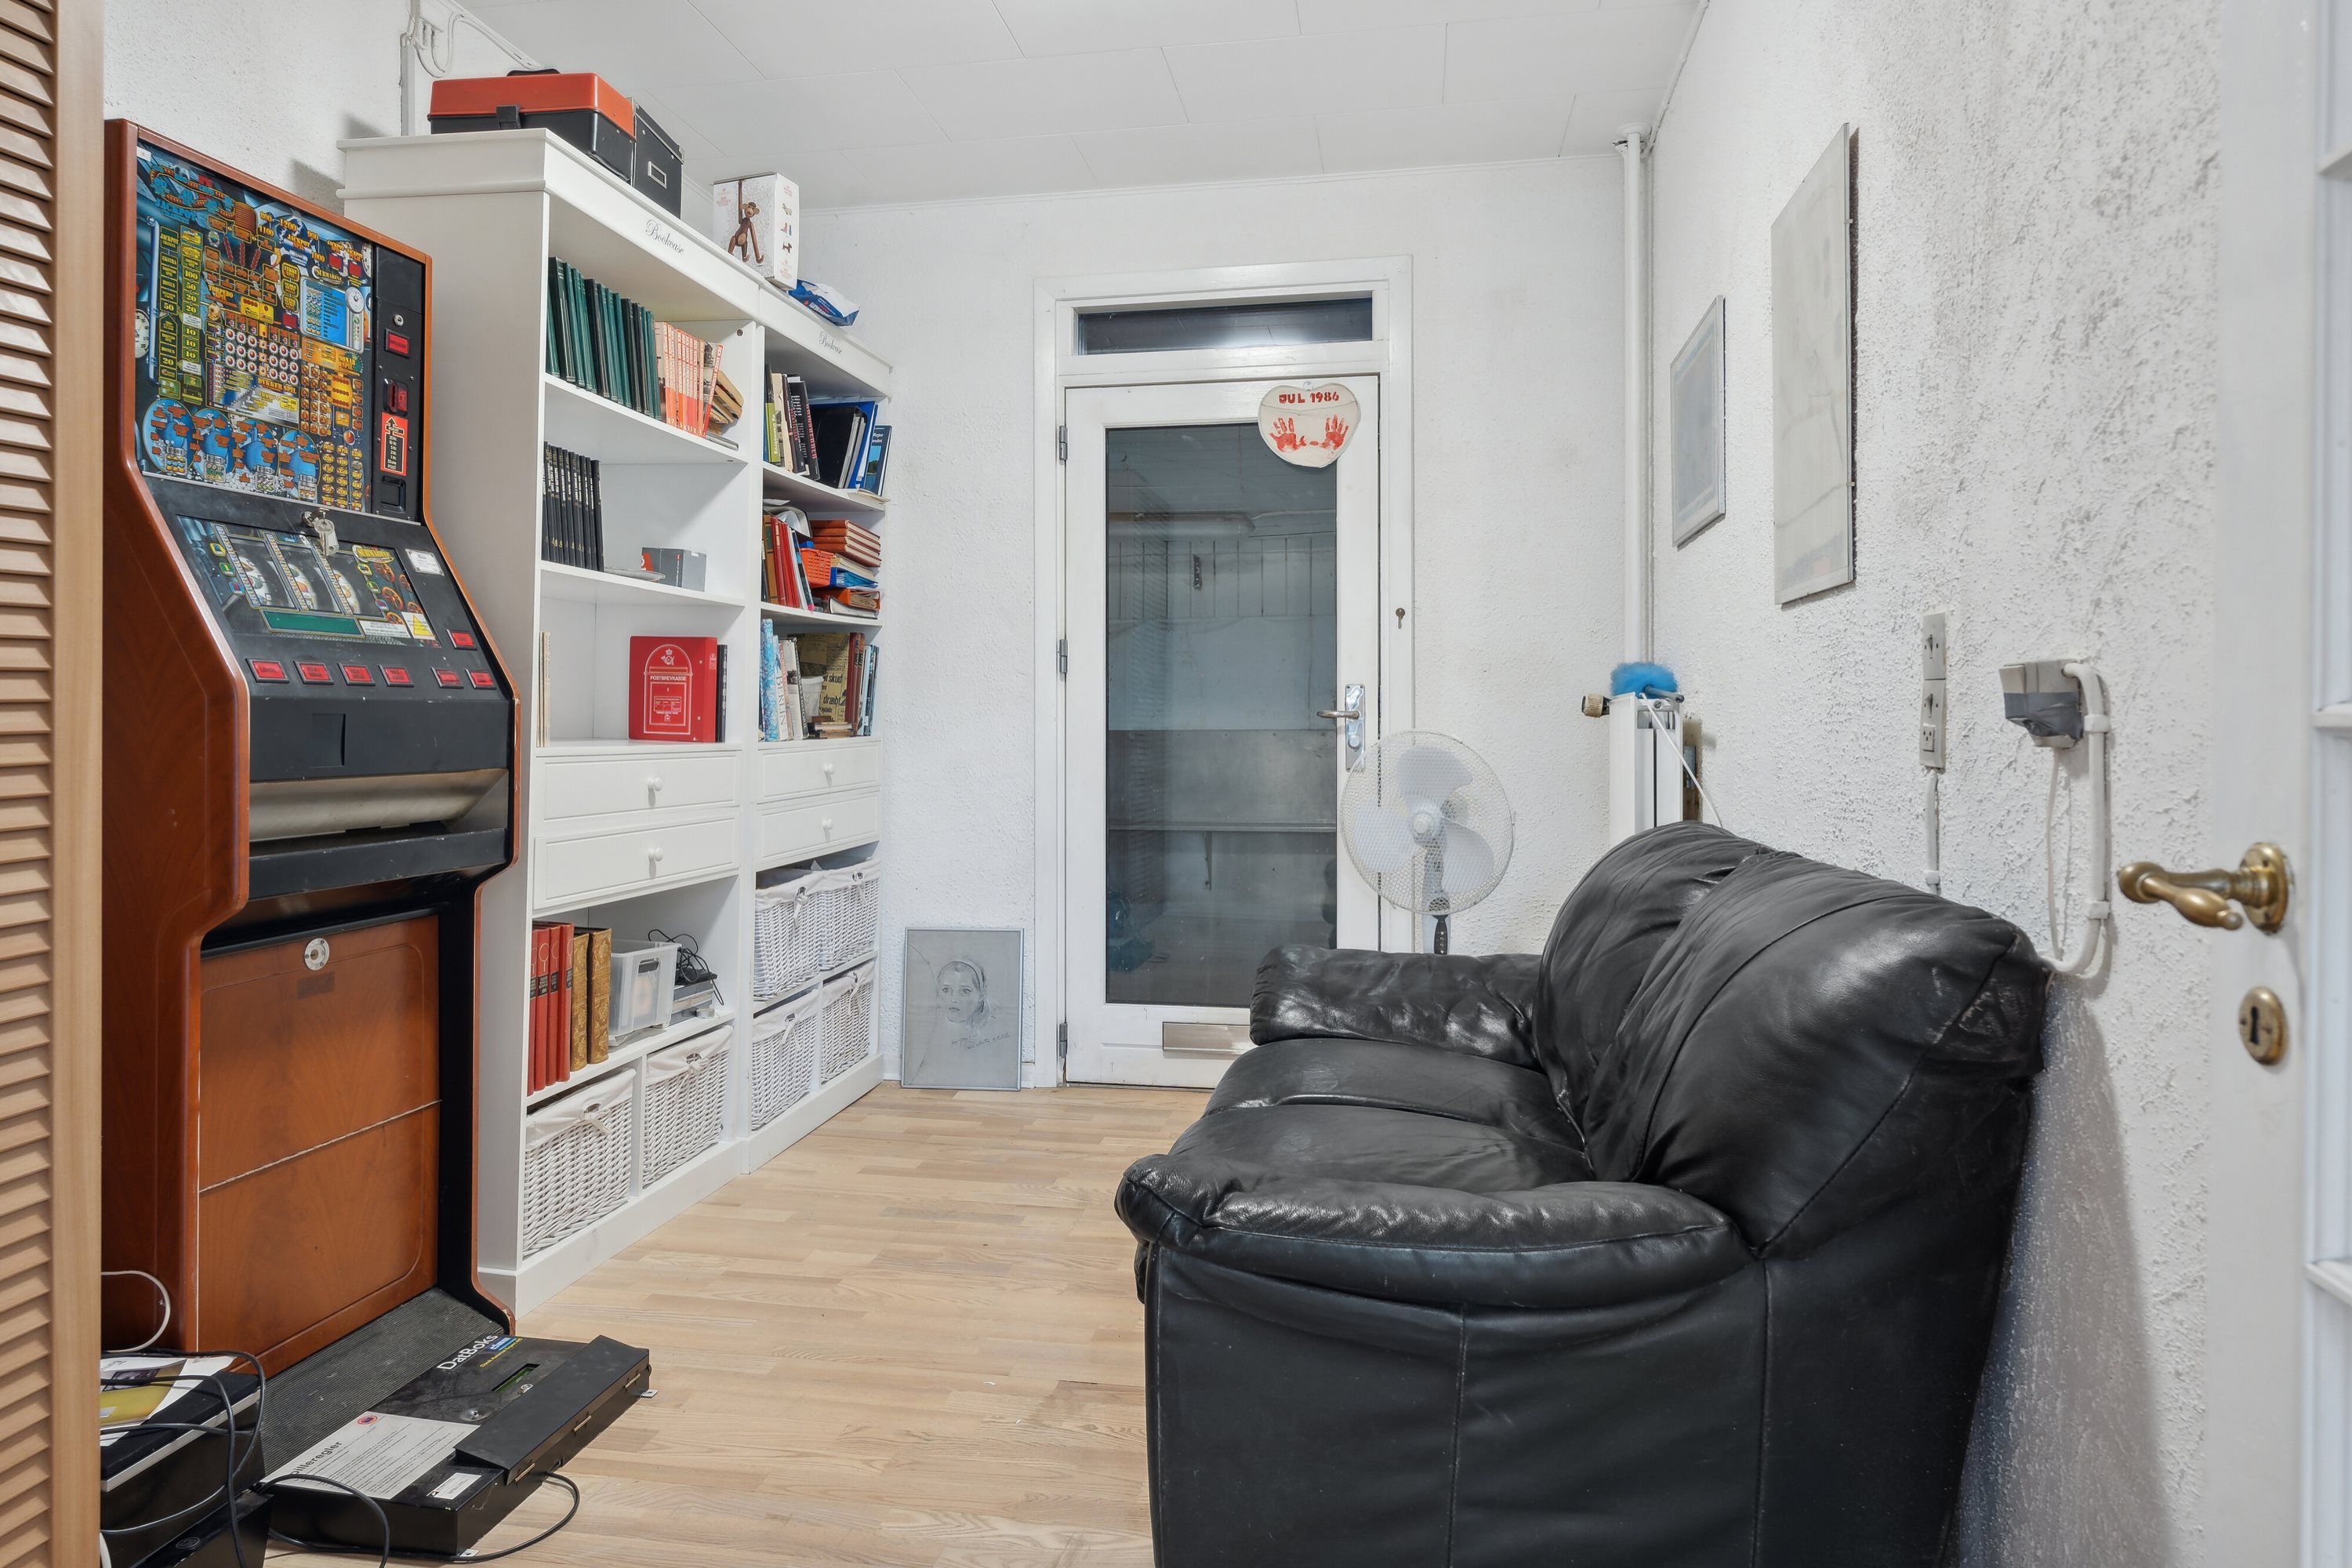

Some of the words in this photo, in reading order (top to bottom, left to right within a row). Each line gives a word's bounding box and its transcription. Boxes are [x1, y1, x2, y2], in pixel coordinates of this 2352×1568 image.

[260, 211, 273, 223] 800
[259, 224, 274, 237] 1100
[279, 217, 297, 233] 1200
[287, 234, 311, 248] JACKPOT
[307, 229, 319, 241] 900
[646, 220, 684, 255] Bookcase
[310, 251, 325, 263] 1000
[185, 270, 198, 280] 100
[187, 282, 196, 291] 50
[186, 293, 197, 302] 20
[163, 303, 174, 311] 50
[186, 304, 197, 314] 20
[819, 332, 842, 354] Bookcase
[1279, 394, 1305, 404] JUL
[829, 673, 843, 684] skud
[776, 676, 786, 726] BERLIN
[823, 695, 841, 706] dræbt
[437, 1334, 499, 1370] DatBoks
[291, 1440, 343, 1475] pilleregler
